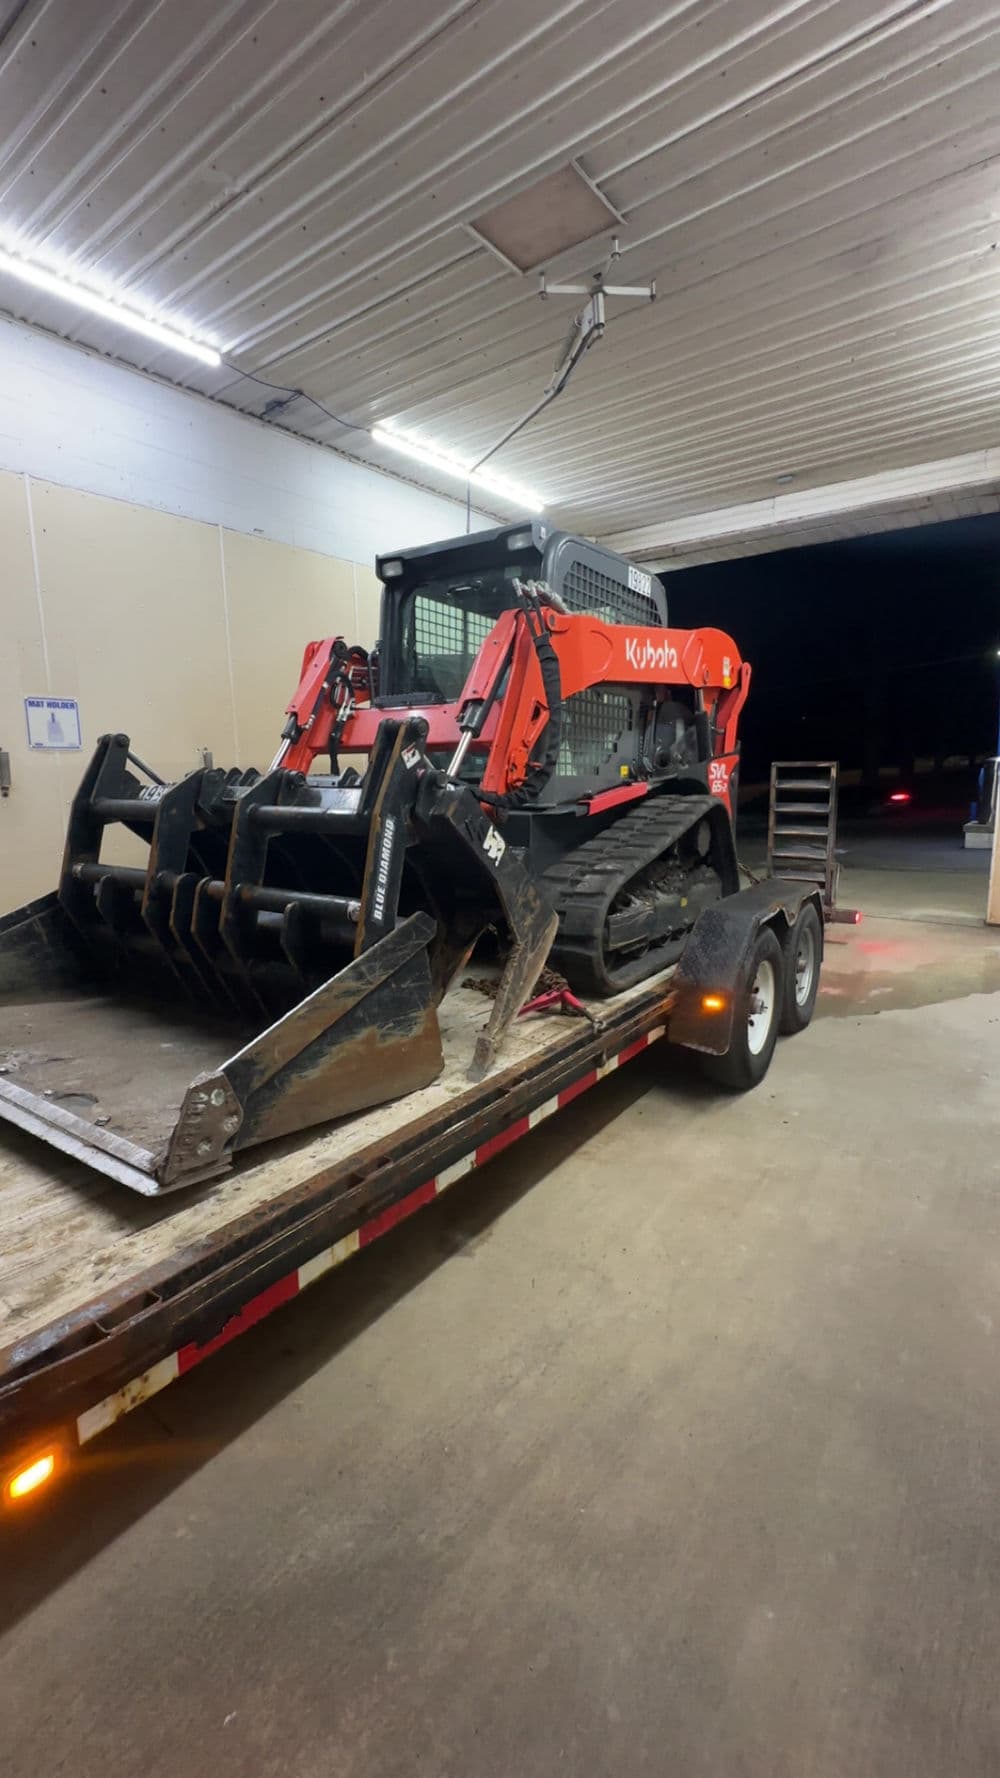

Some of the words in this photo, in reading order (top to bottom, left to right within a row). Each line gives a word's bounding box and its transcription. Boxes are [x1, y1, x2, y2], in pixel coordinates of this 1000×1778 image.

[625, 637, 678, 669] Kubota
[28, 700, 44, 708] MAT
[46, 701, 75, 709] HOLDER
[708, 763, 729, 779] SVL
[378, 818, 395, 885] DIAMOND
[373, 886, 386, 921] BLUE
